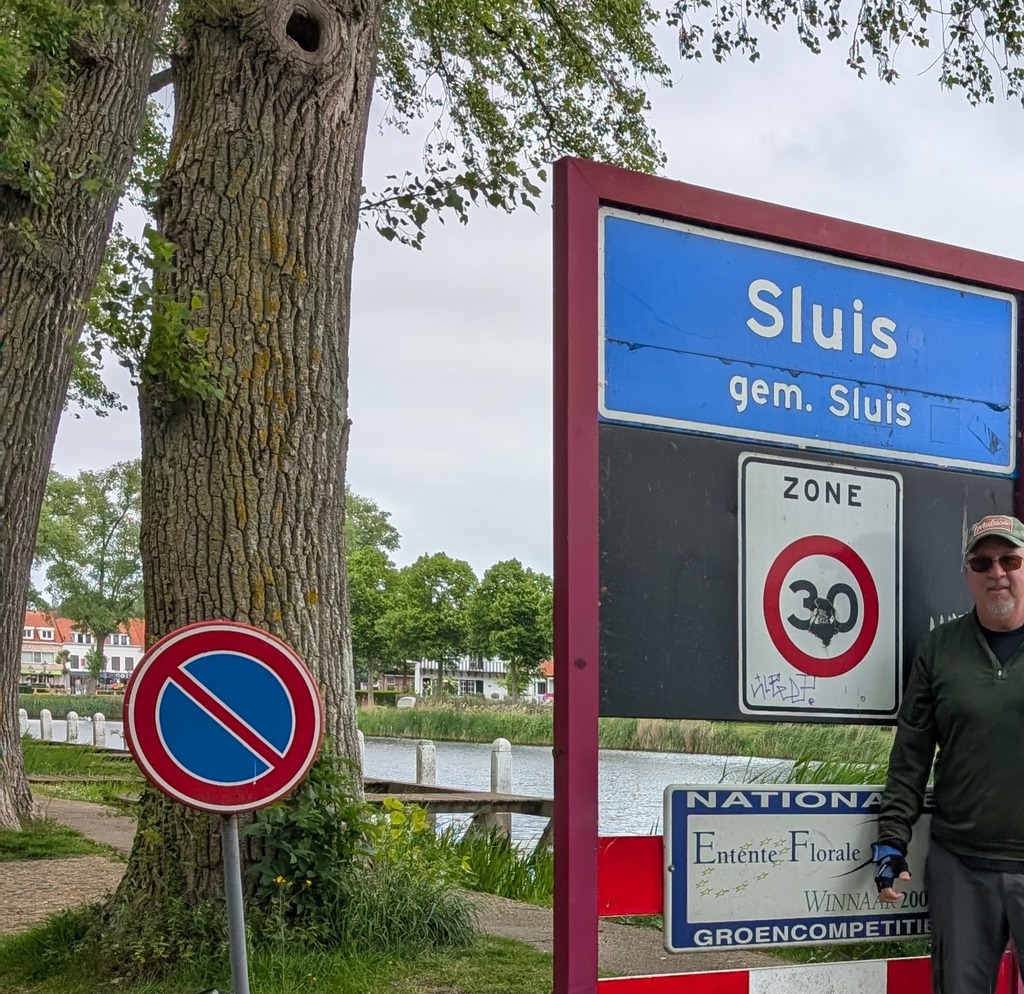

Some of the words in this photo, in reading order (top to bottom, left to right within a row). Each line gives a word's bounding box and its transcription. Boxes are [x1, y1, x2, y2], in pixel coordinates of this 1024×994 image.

[746, 279, 898, 360] Sluis
[729, 375, 813, 413] gem.
[829, 384, 911, 427] Sluis
[783, 476, 862, 508] ZONE
[786, 579, 859, 634] 30
[686, 791, 936, 809] NATIONAE
[692, 830, 778, 865] Entente
[788, 830, 861, 863] Florale
[900, 890, 929, 909] 200
[693, 917, 933, 947] GROENCOMPETITIE
